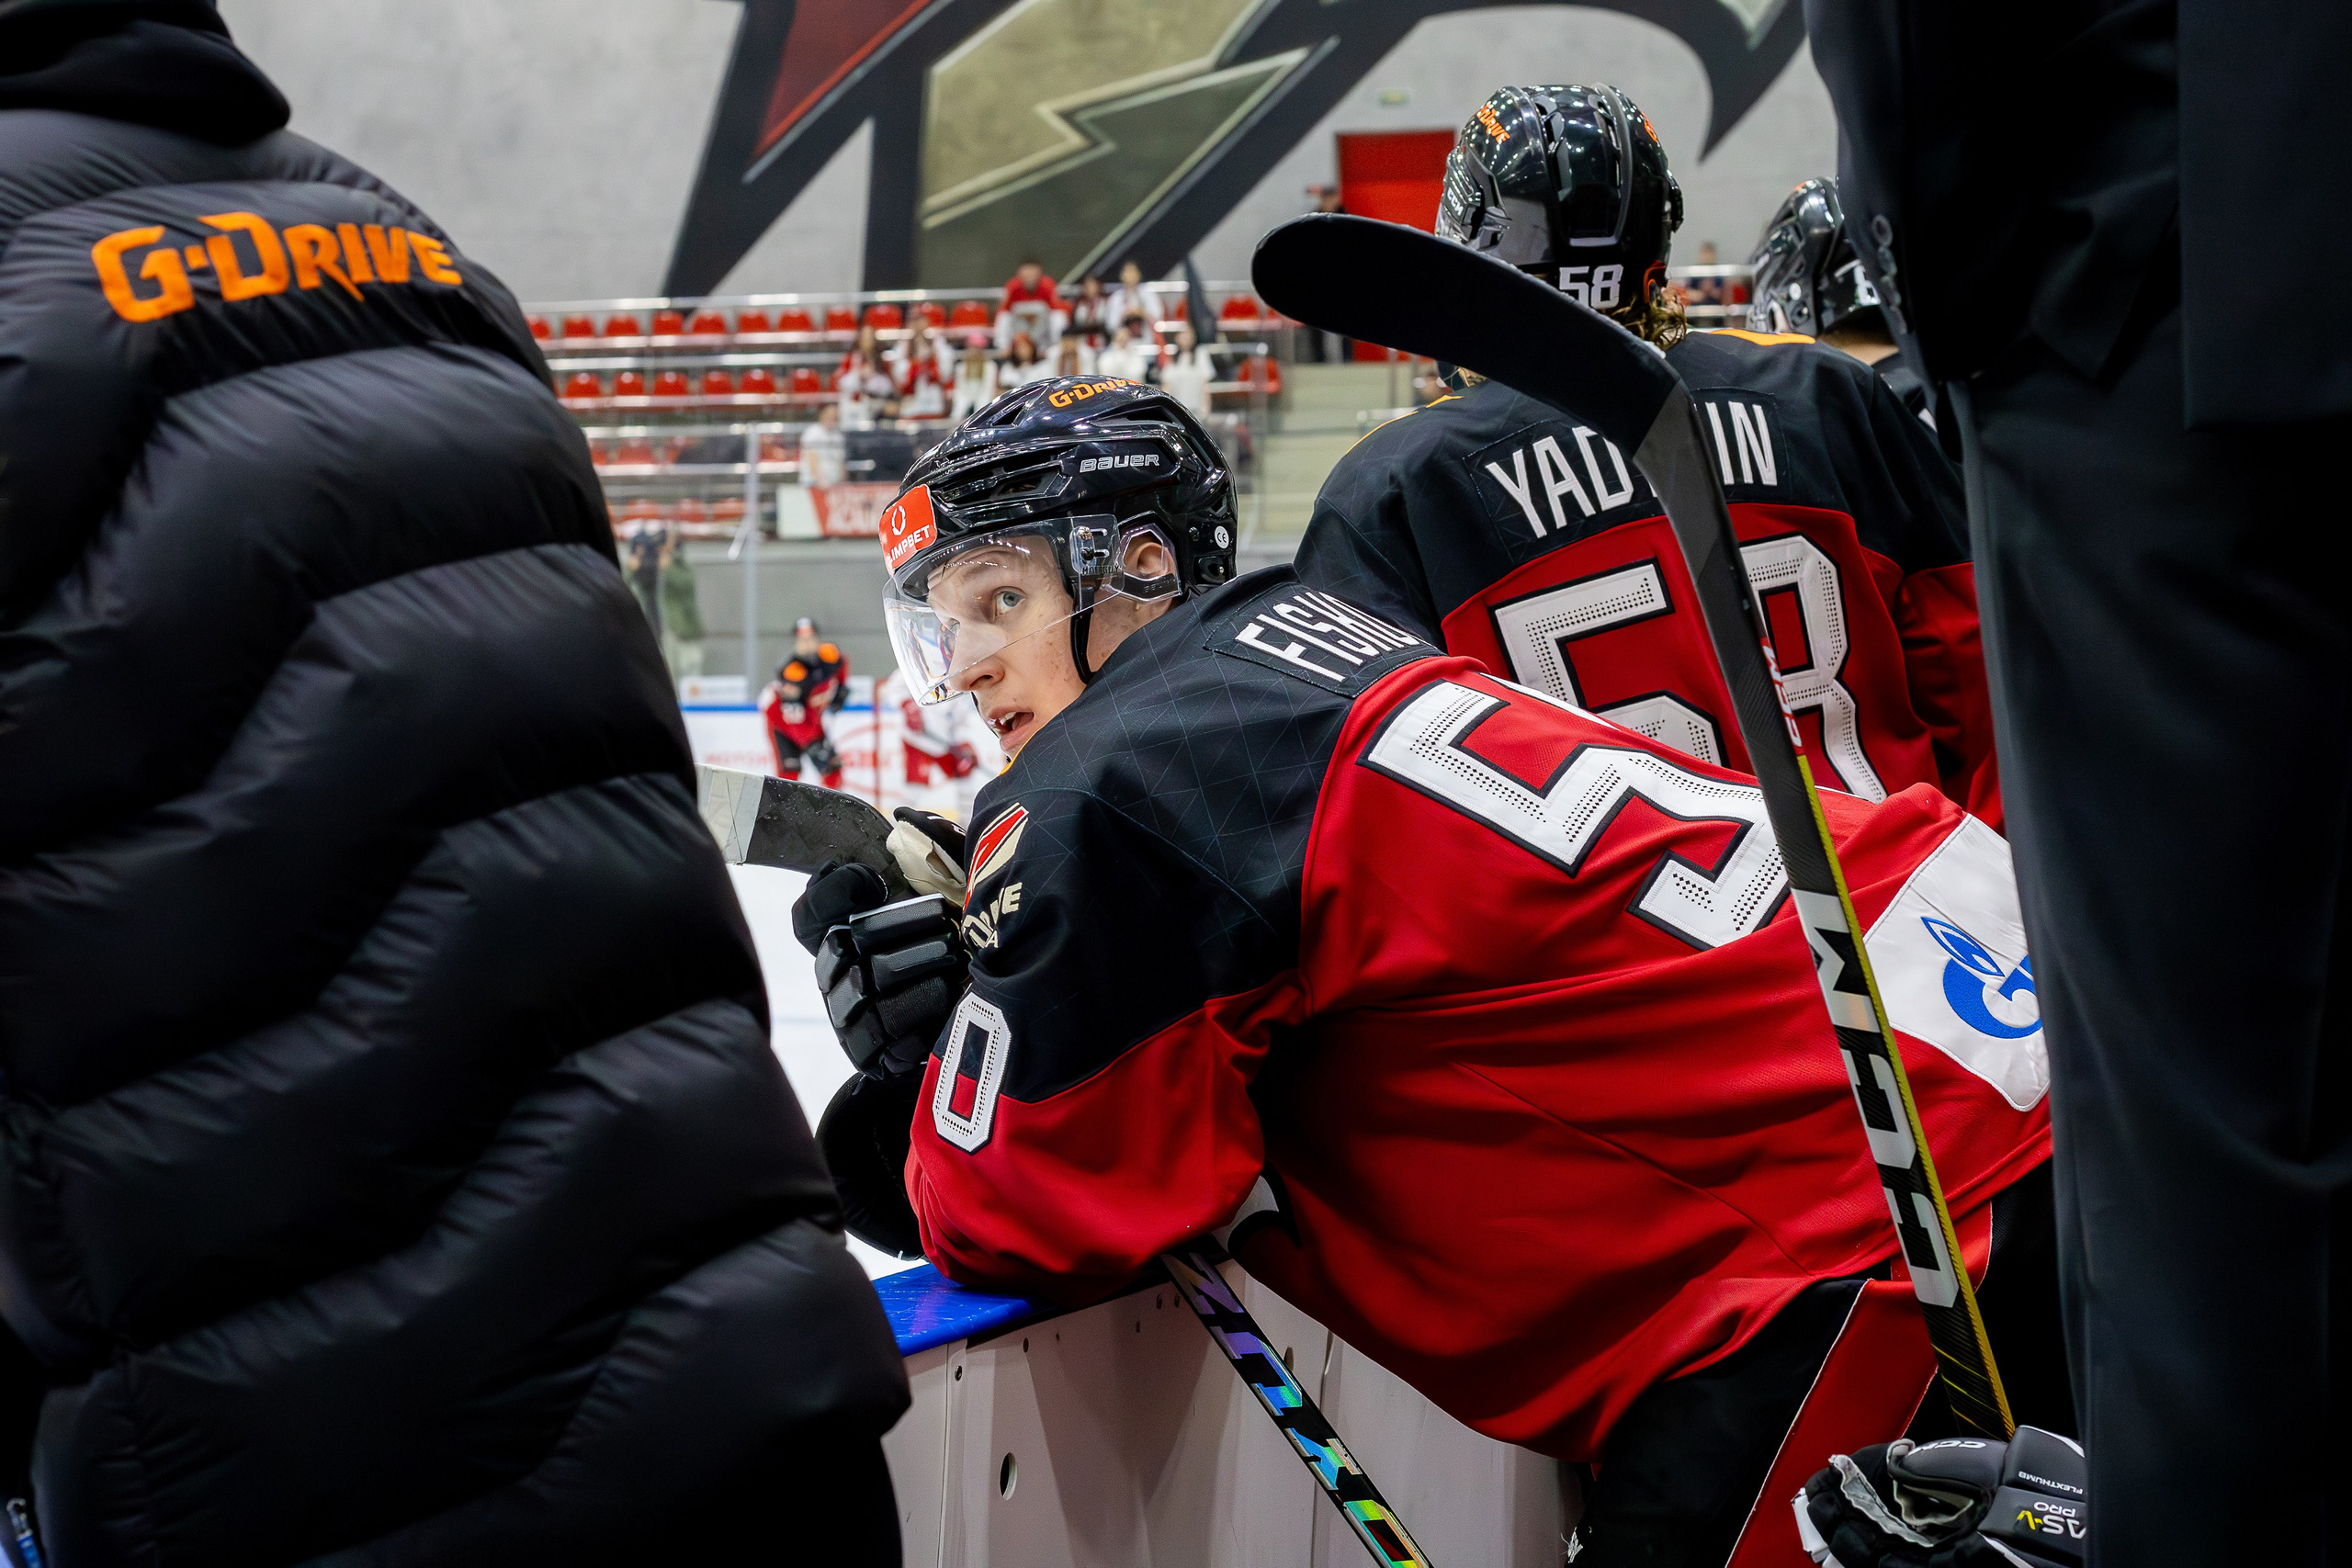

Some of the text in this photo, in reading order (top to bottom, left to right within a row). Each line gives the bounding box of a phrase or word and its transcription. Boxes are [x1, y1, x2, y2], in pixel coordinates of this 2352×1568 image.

[1447, 186, 1464, 217] CCM
[92, 212, 462, 322] G-DRIVE
[1559, 265, 1623, 310] 58
[1485, 400, 1778, 538] YADIN
[1235, 592, 1431, 682] FISKO
[1362, 678, 1793, 950] 5
[1791, 888, 1960, 1309] CCM
[2018, 1471, 2084, 1495] FLEXTHUMB
[2033, 1501, 2076, 1517] PRO
